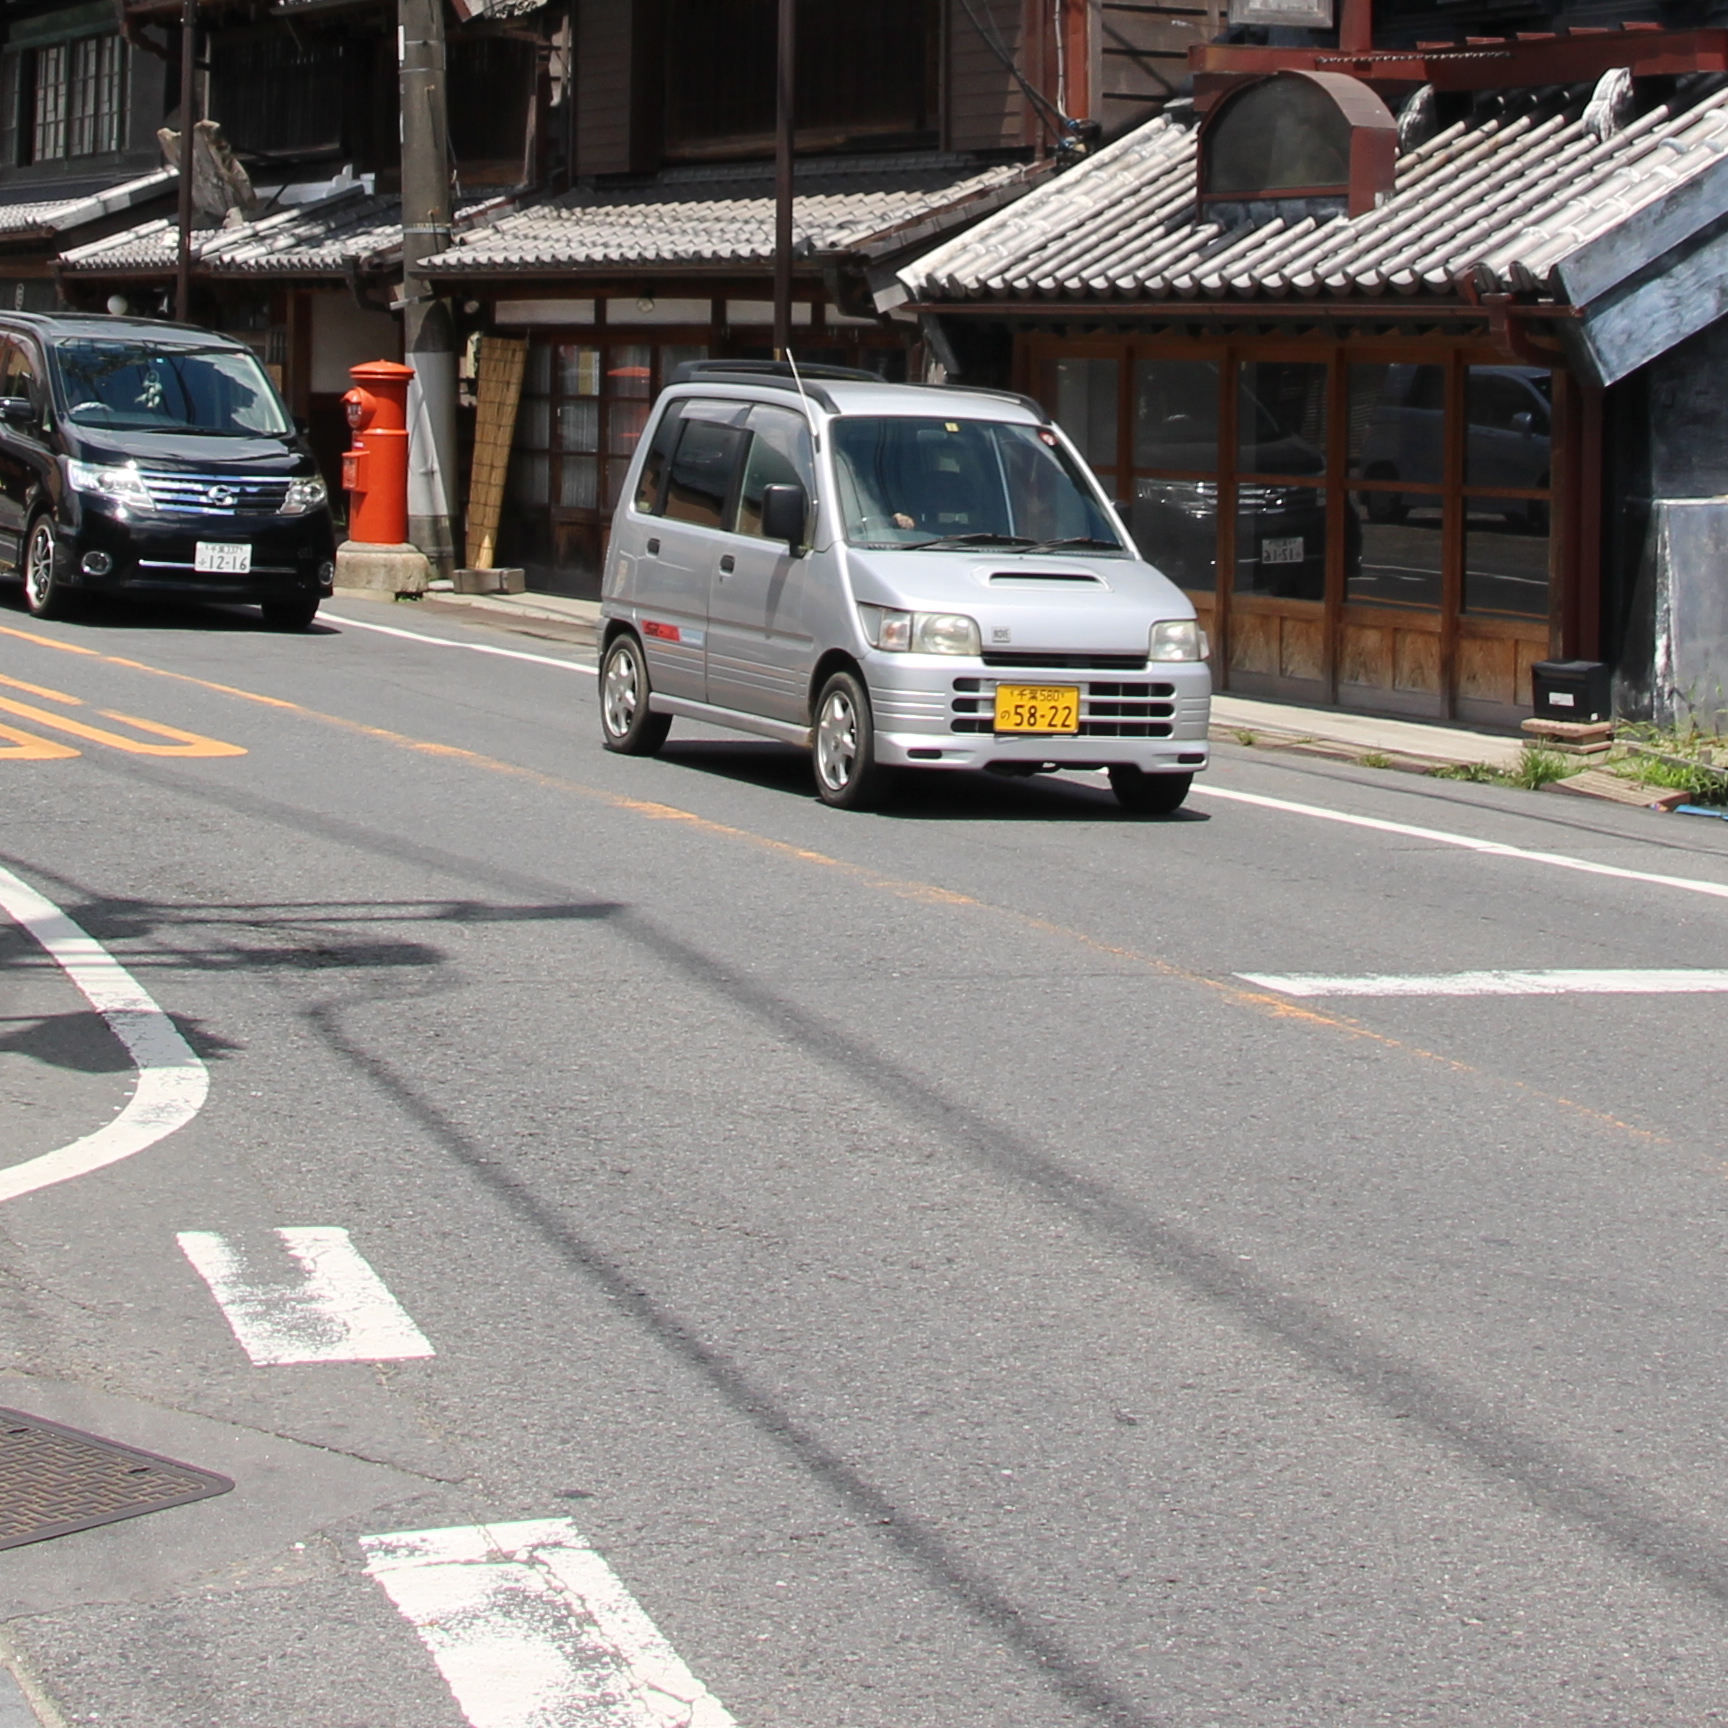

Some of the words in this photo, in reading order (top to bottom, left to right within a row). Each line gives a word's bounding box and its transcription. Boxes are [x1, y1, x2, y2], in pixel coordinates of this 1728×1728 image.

[208, 554, 248, 571] 12-16
[1016, 688, 1060, 703] 千葉580
[1000, 709, 1011, 721] の
[1013, 704, 1073, 728] 58-22
